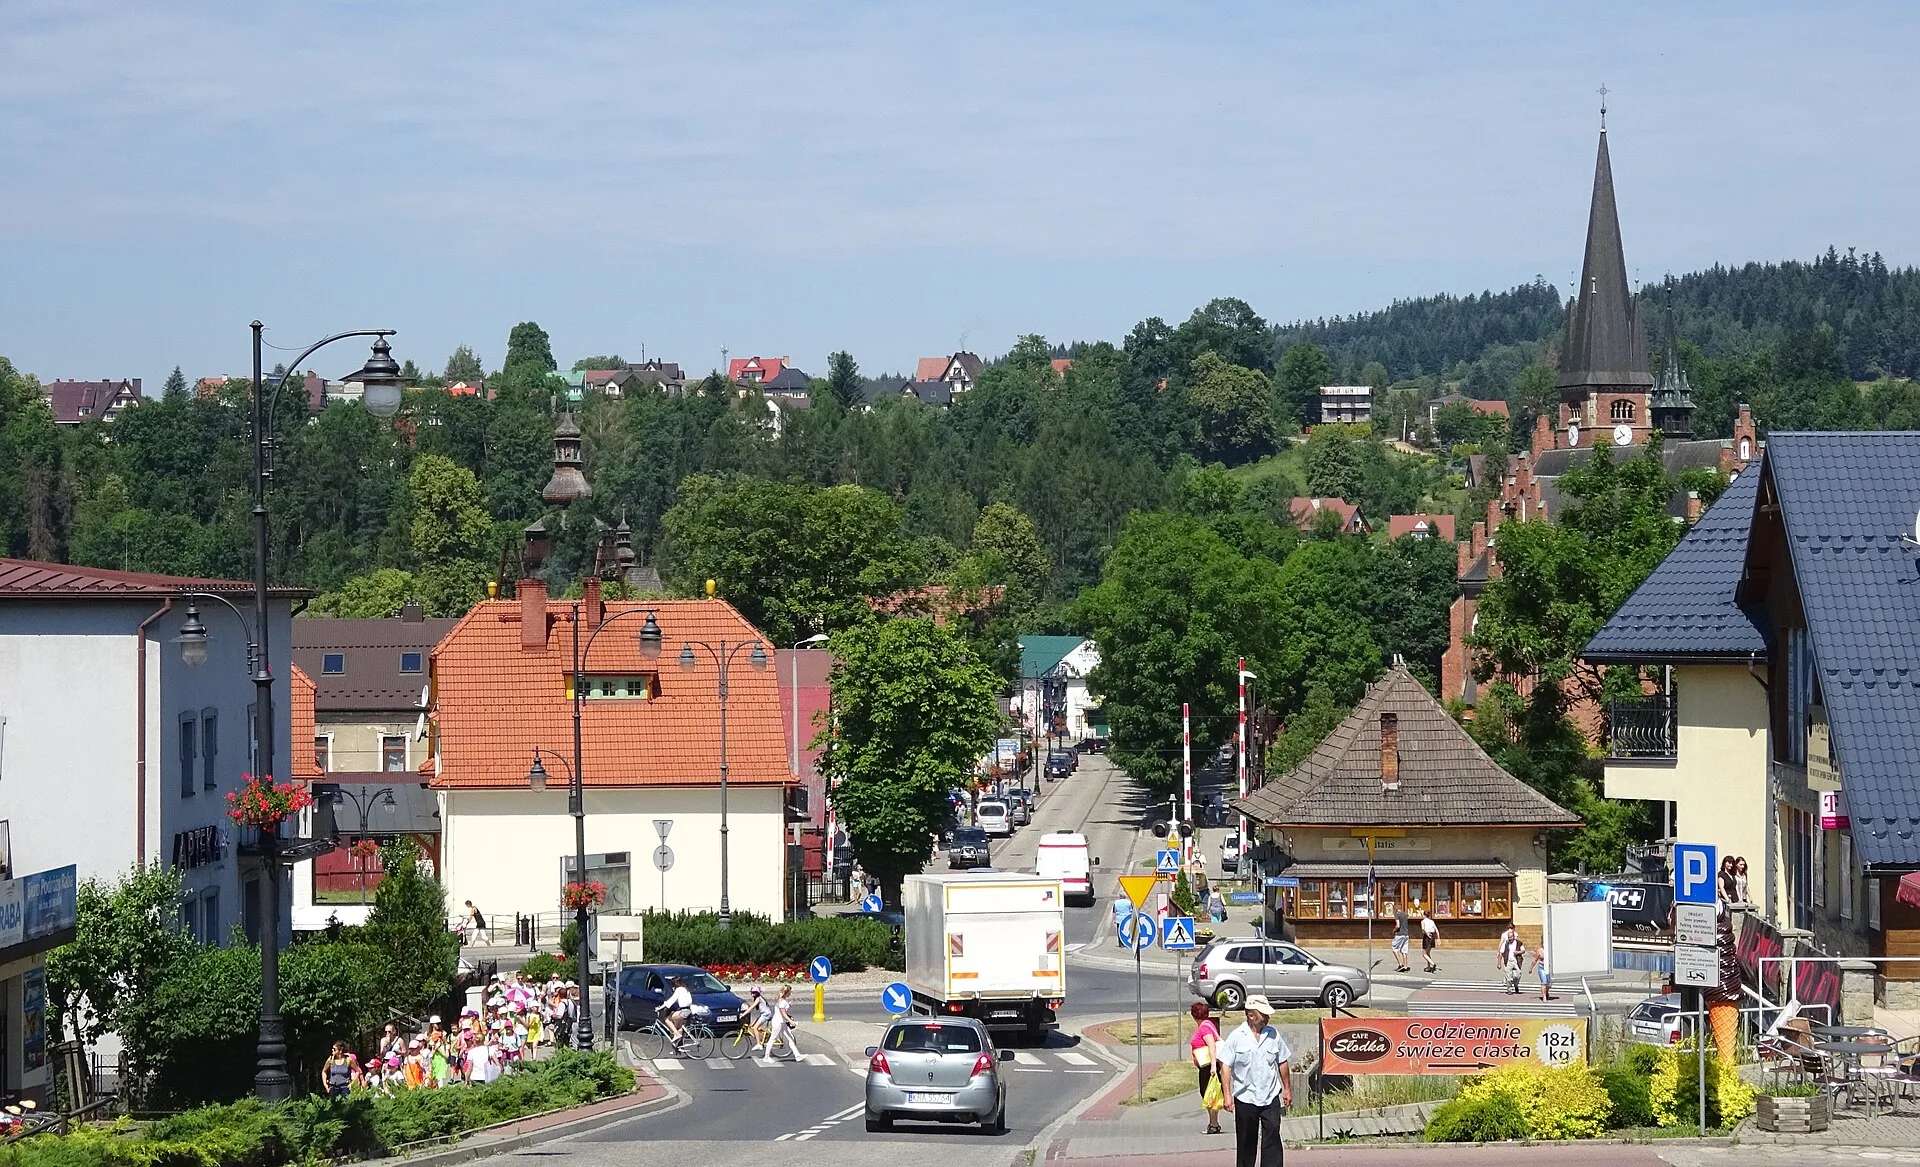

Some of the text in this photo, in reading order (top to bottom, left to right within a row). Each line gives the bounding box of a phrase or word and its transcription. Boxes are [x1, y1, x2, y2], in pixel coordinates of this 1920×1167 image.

[1683, 851, 1708, 896] P
[1406, 1023, 1521, 1039] Codziennie
[1333, 1038, 1387, 1052] Słodka
[1396, 1041, 1531, 1058] świeże ciasta
[1549, 1046, 1569, 1064] kg
